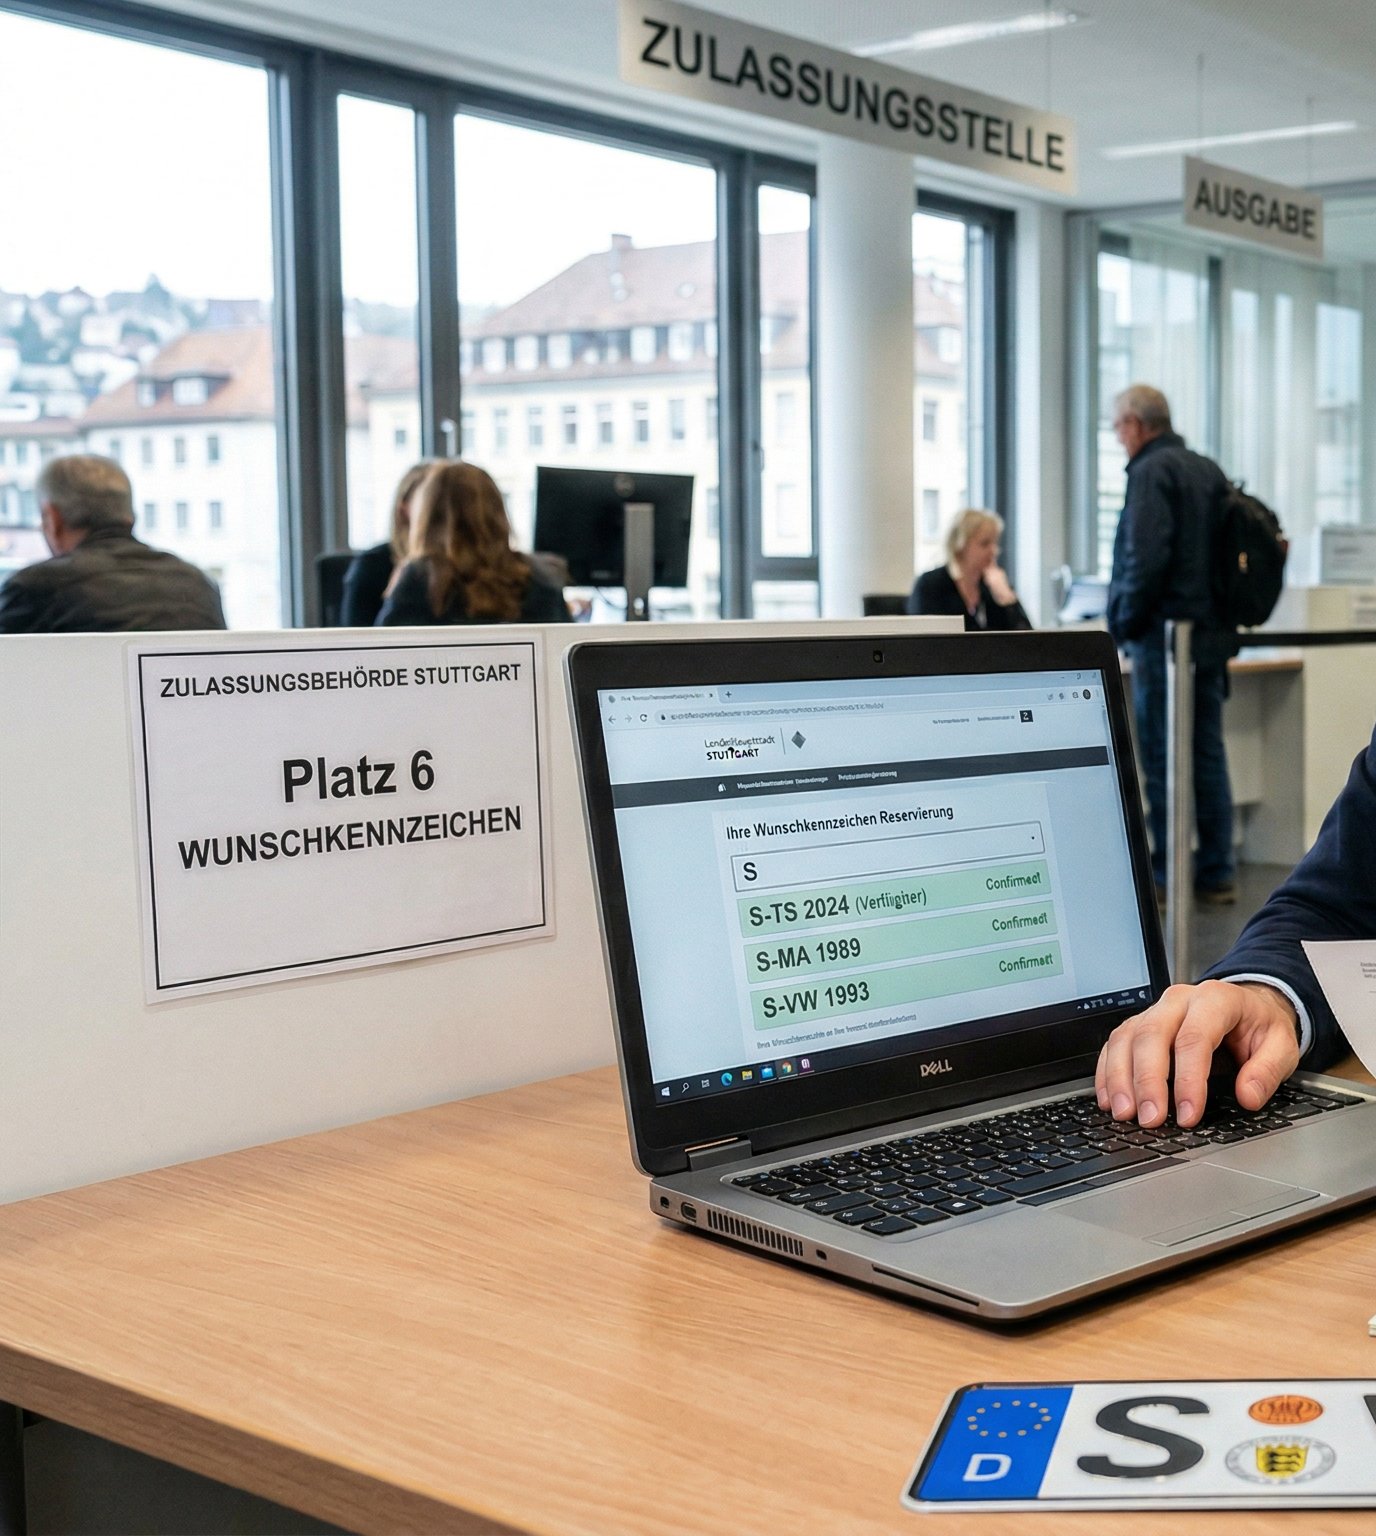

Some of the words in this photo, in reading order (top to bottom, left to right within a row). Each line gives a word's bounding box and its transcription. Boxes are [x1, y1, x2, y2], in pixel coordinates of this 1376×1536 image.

[640, 17, 1065, 174] ZULASSUNGSSTELLE
[1193, 177, 1317, 241] AUSGABE
[160, 665, 409, 698] ZULASSUNGSBEHÖRDE
[414, 663, 522, 686] STUTTGART
[282, 754, 397, 803] Platz
[410, 749, 436, 791] 6
[178, 805, 523, 870] WUNSCHKENNZEICHEN
[726, 826, 751, 840] Ihre
[753, 815, 877, 837] Wunschkennzeichen
[879, 807, 954, 824] Reservierung
[743, 861, 758, 882] S
[750, 901, 798, 927] S-TS
[803, 894, 850, 920] 2024
[756, 945, 812, 972] S-MA
[816, 937, 861, 963] 1989
[762, 989, 818, 1019] S-VW
[824, 981, 870, 1008] 1993
[920, 1058, 953, 1078] DELL
[1077, 1395, 1210, 1479] S
[962, 1453, 1012, 1483] D
